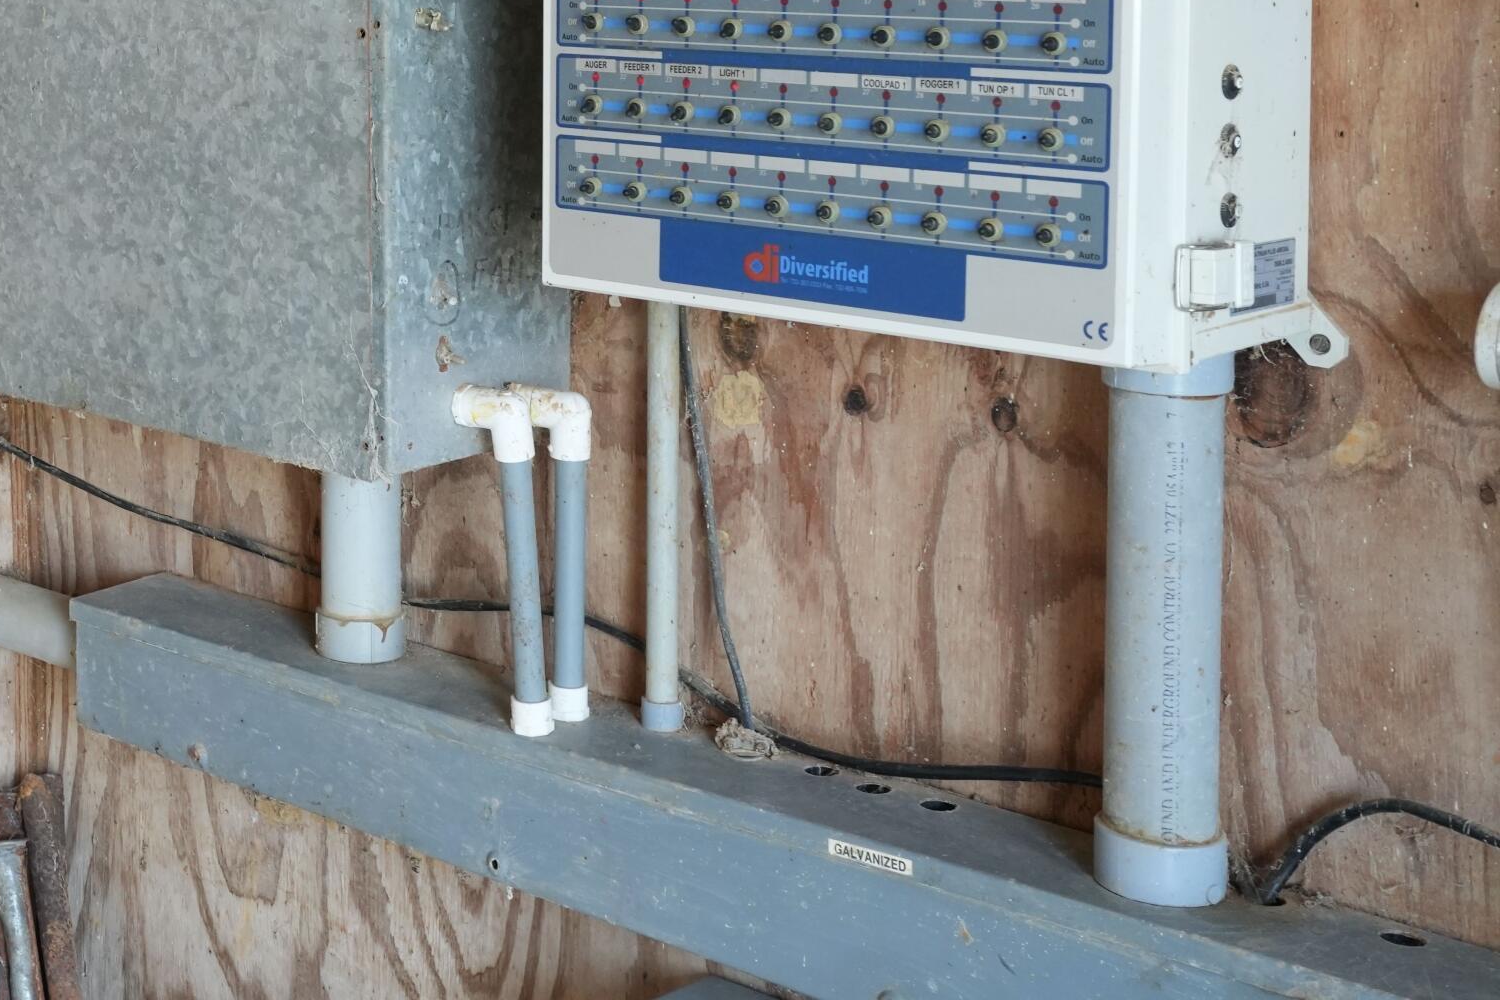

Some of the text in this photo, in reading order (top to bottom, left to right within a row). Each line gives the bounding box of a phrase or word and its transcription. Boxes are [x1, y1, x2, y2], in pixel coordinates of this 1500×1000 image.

[1083, 19, 1095, 27] On
[1083, 39, 1096, 48] Off
[585, 61, 607, 69] AUGER
[1083, 57, 1105, 66] Auto
[624, 63, 649, 71] FEEDER
[670, 66, 696, 74] FEEDER
[719, 69, 739, 78] LIGHT
[863, 78, 901, 89] COOLPAD
[920, 80, 953, 89] FOGGER
[978, 84, 995, 94] TUN
[997, 85, 1009, 94] OP
[1038, 87, 1055, 96] TUN
[1057, 87, 1068, 97] CL
[1081, 116, 1093, 125] On
[1080, 137, 1094, 145] Off
[1080, 155, 1102, 163] Auto
[1079, 213, 1091, 222] On
[1079, 252, 1100, 261] Auto
[780, 255, 869, 285] Diversified
[834, 843, 906, 872] GALVANIZED
